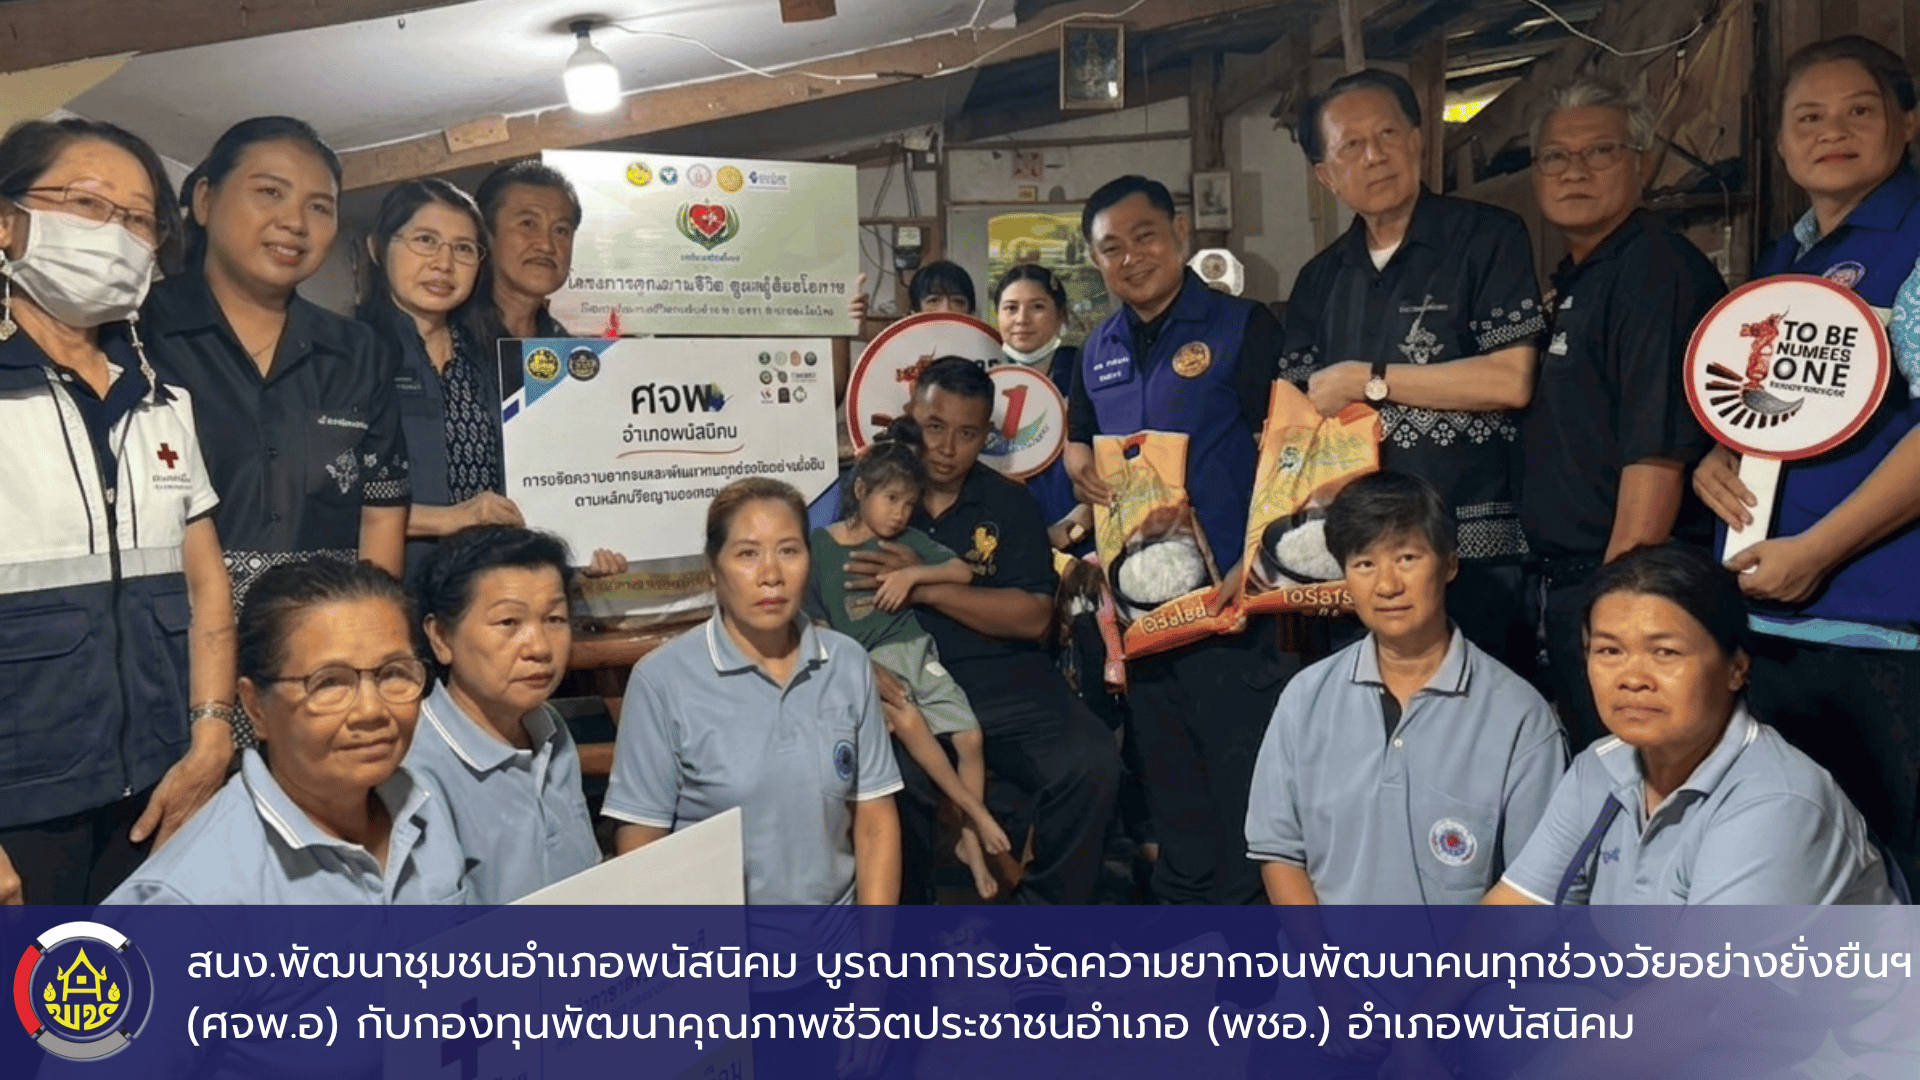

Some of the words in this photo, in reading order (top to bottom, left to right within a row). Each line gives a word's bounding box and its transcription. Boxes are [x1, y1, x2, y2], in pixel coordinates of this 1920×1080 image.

[1783, 320, 1818, 343] TO
[1825, 324, 1859, 348] BE
[1773, 357, 1851, 388] ONE
